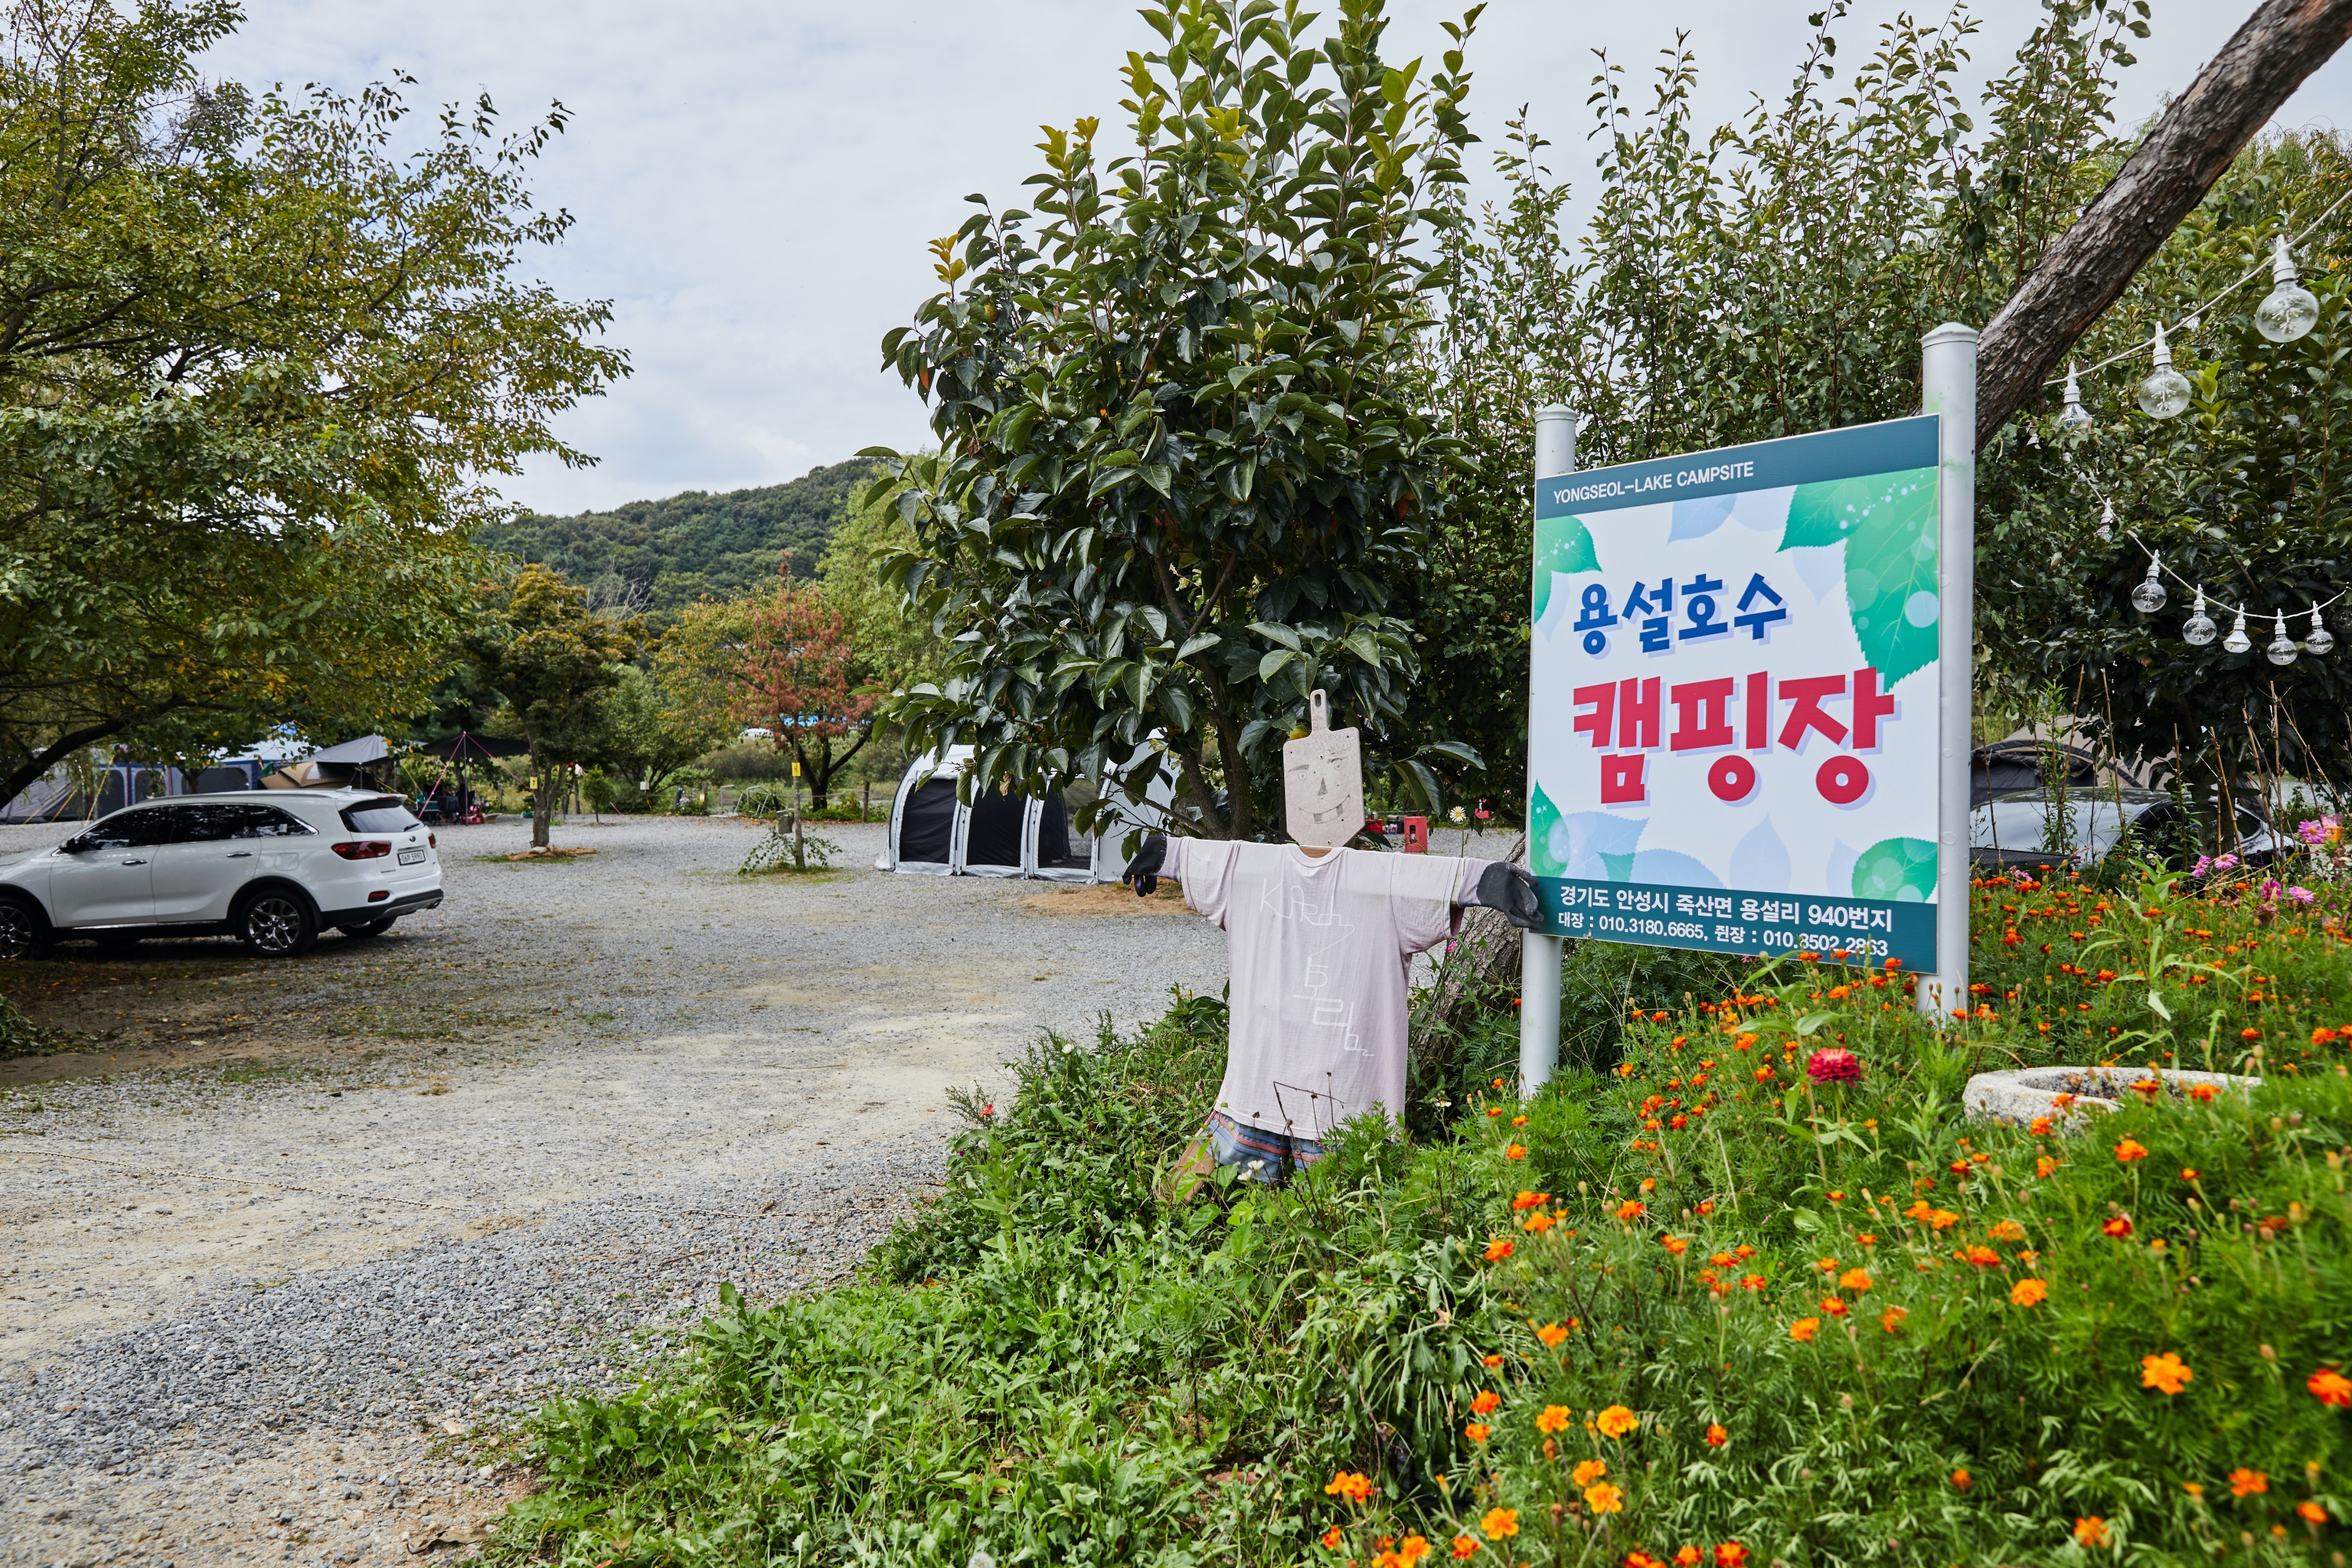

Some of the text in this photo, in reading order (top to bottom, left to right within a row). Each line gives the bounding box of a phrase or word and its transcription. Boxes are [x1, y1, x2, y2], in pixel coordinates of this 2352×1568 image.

[1553, 461, 1754, 504] YONGSEOL-LAKE CAMPSITE
[1573, 572, 1787, 655] 용설호수
[1573, 666, 1894, 804] 캠핑장
[1558, 911, 1584, 929] 대장
[1599, 915, 1708, 942] 010.3180.6665,
[1714, 924, 1746, 944] 쥔장
[1560, 886, 1892, 933] 경기도 안성시 죽산면 용설리 940번지
